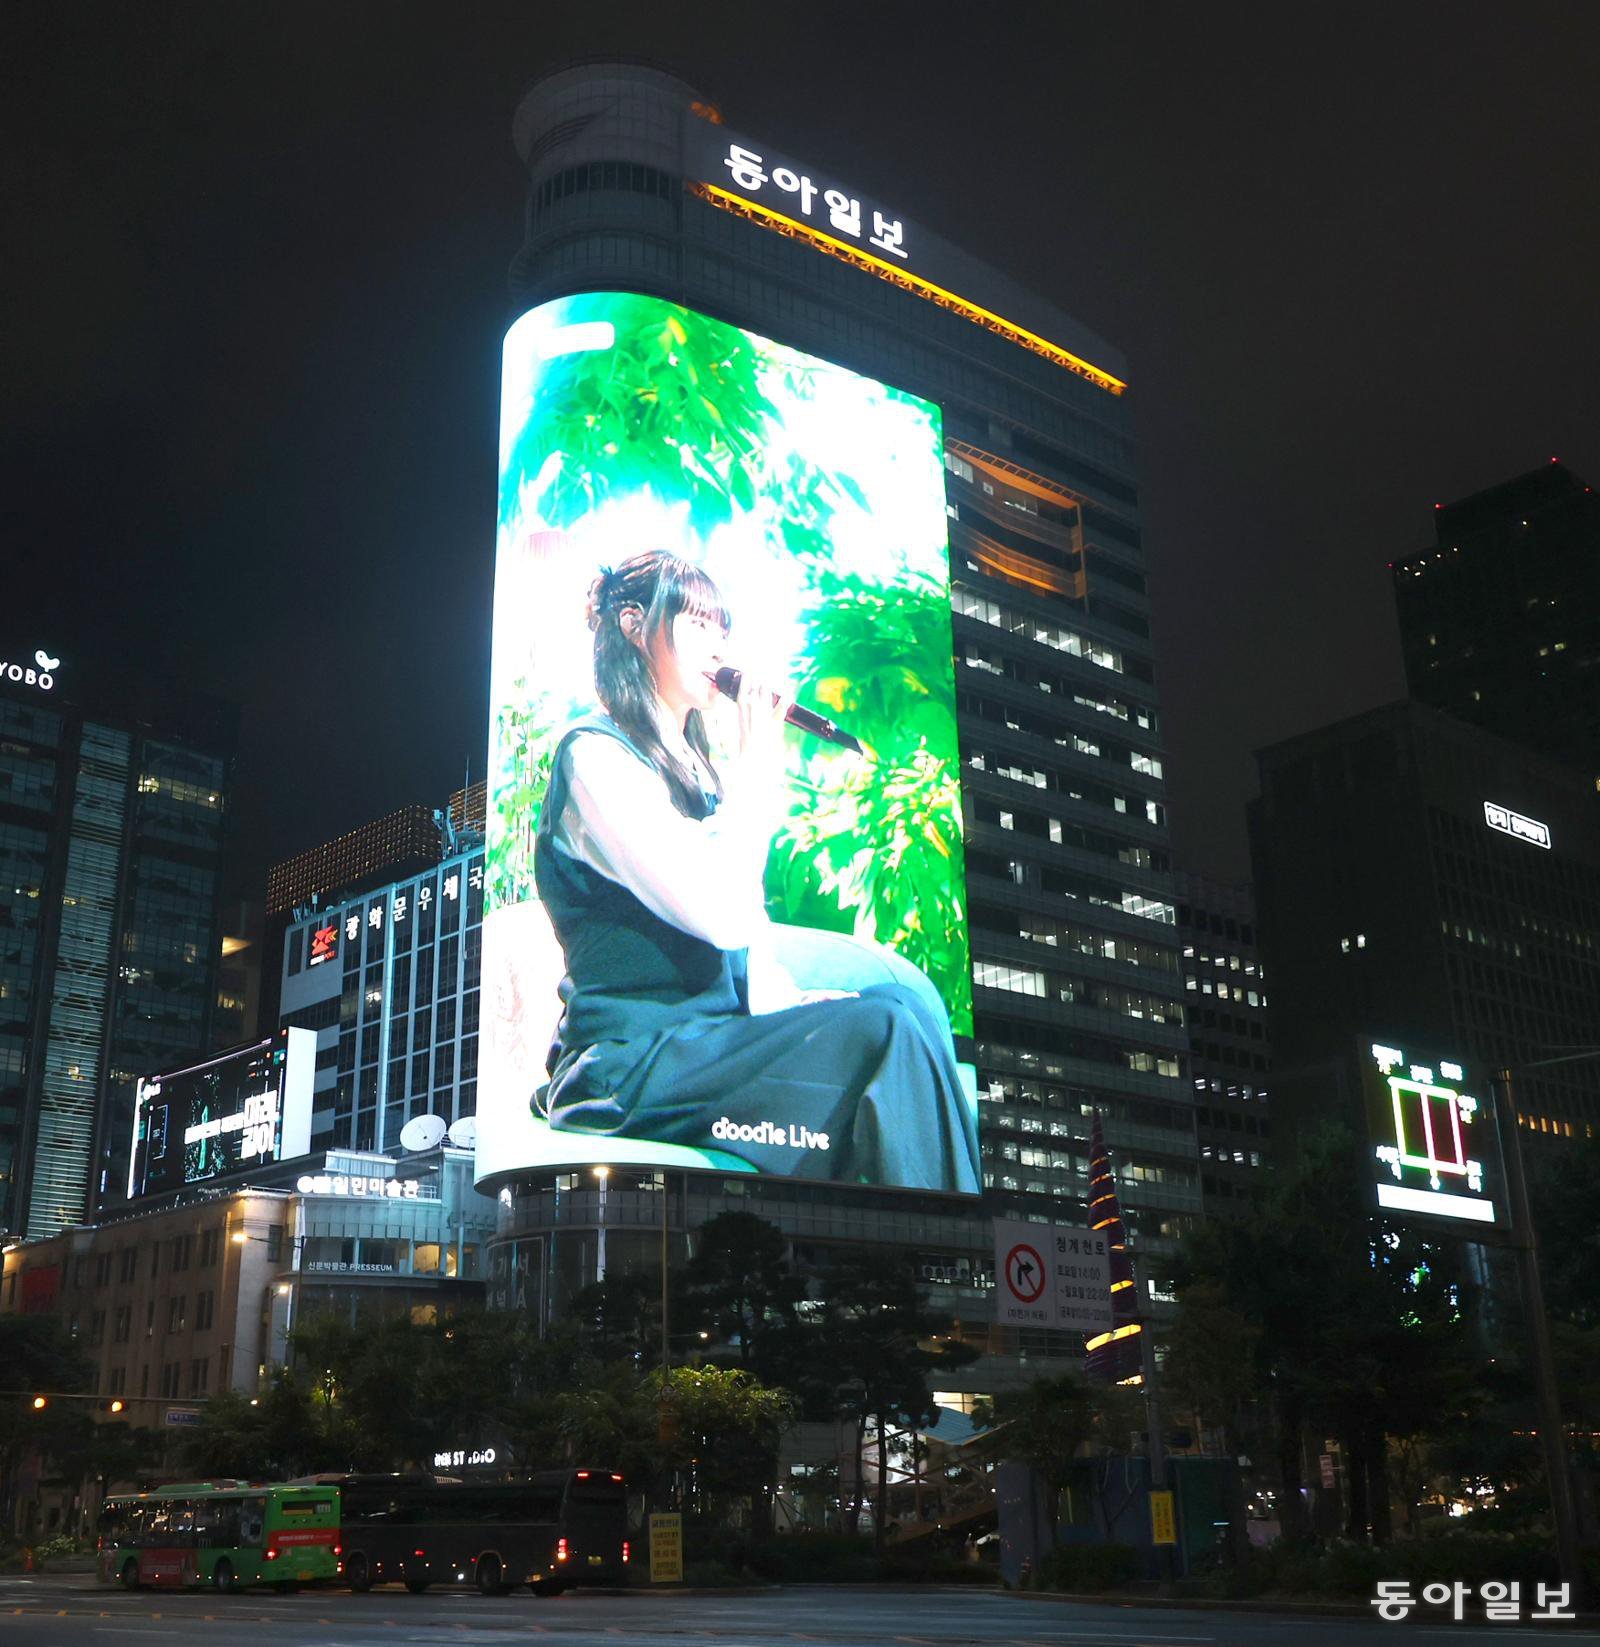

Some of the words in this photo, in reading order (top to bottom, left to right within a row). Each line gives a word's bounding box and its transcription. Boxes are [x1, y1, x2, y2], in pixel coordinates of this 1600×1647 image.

[723, 143, 909, 263] 동아일보
[345, 866, 484, 941] 광화문우체국
[711, 1116, 787, 1146] doodle
[789, 1124, 830, 1151] Live
[1056, 1236, 1106, 1256] 청계천로
[307, 1261, 347, 1271] 신문박물관
[349, 1262, 393, 1272] PRESSEUM
[453, 1448, 496, 1466] STDIO
